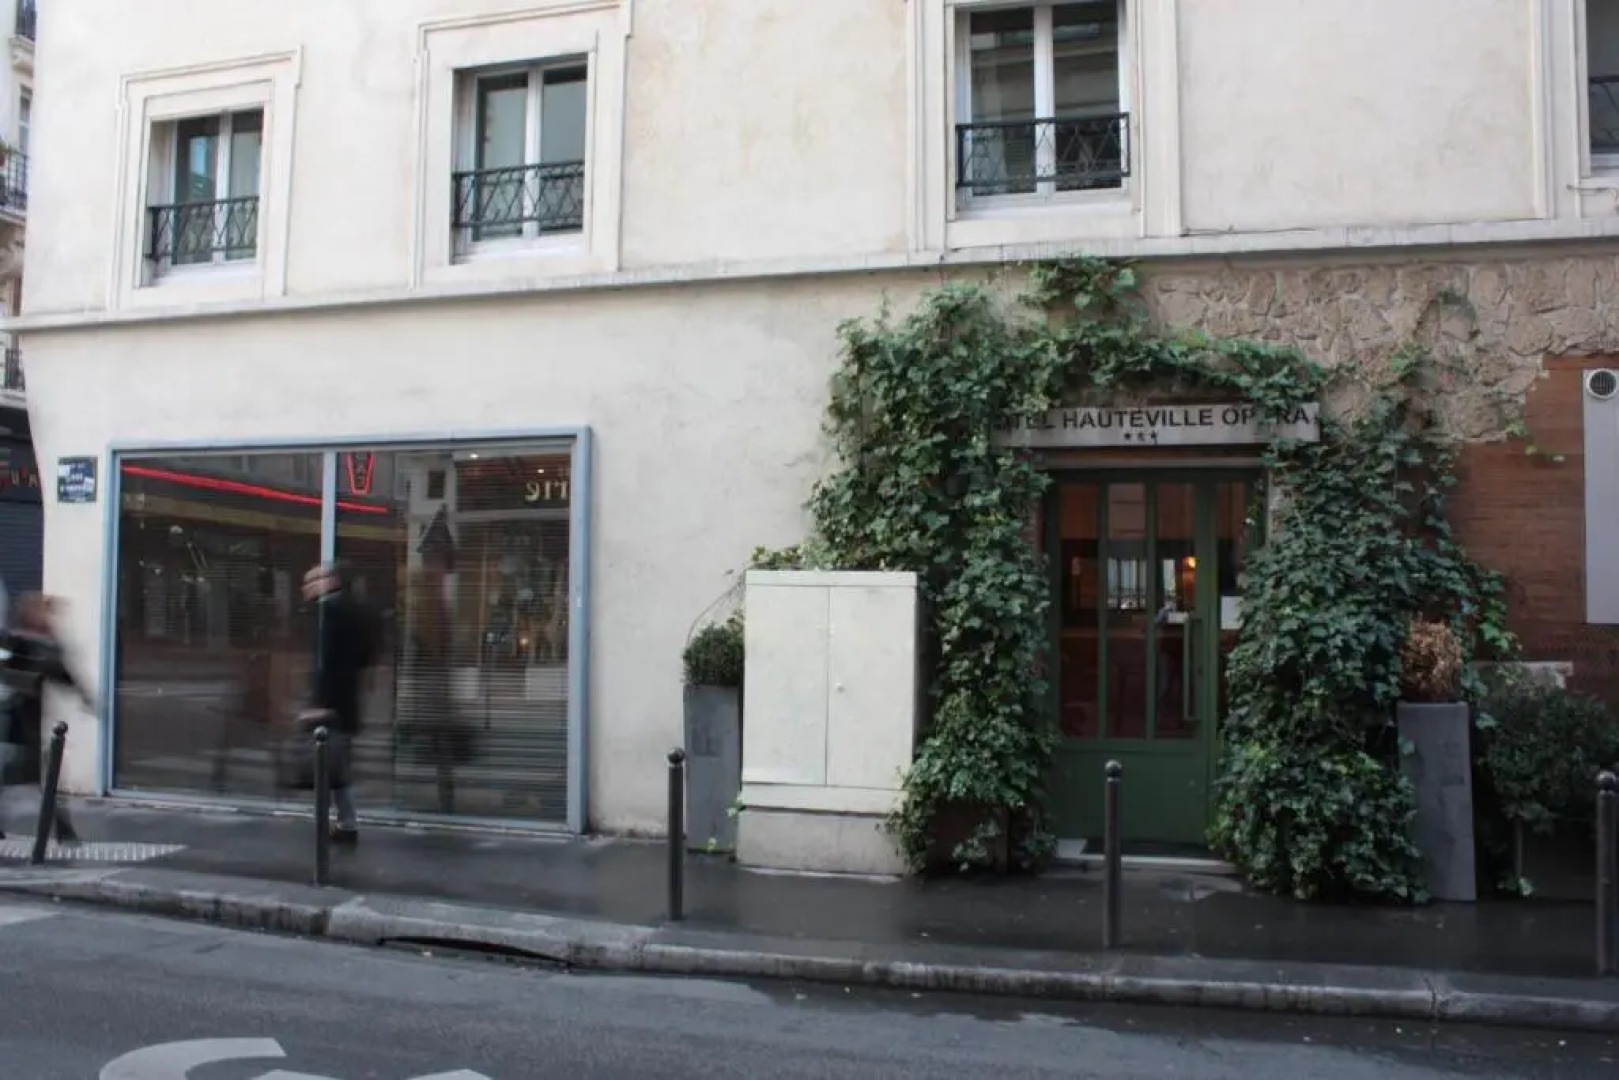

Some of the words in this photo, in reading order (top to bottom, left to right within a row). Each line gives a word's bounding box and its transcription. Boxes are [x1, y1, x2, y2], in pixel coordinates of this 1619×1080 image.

[991, 410, 1056, 431] TEL
[1062, 408, 1213, 429] HAUTEVILLE
[1221, 406, 1311, 426] OPRA
